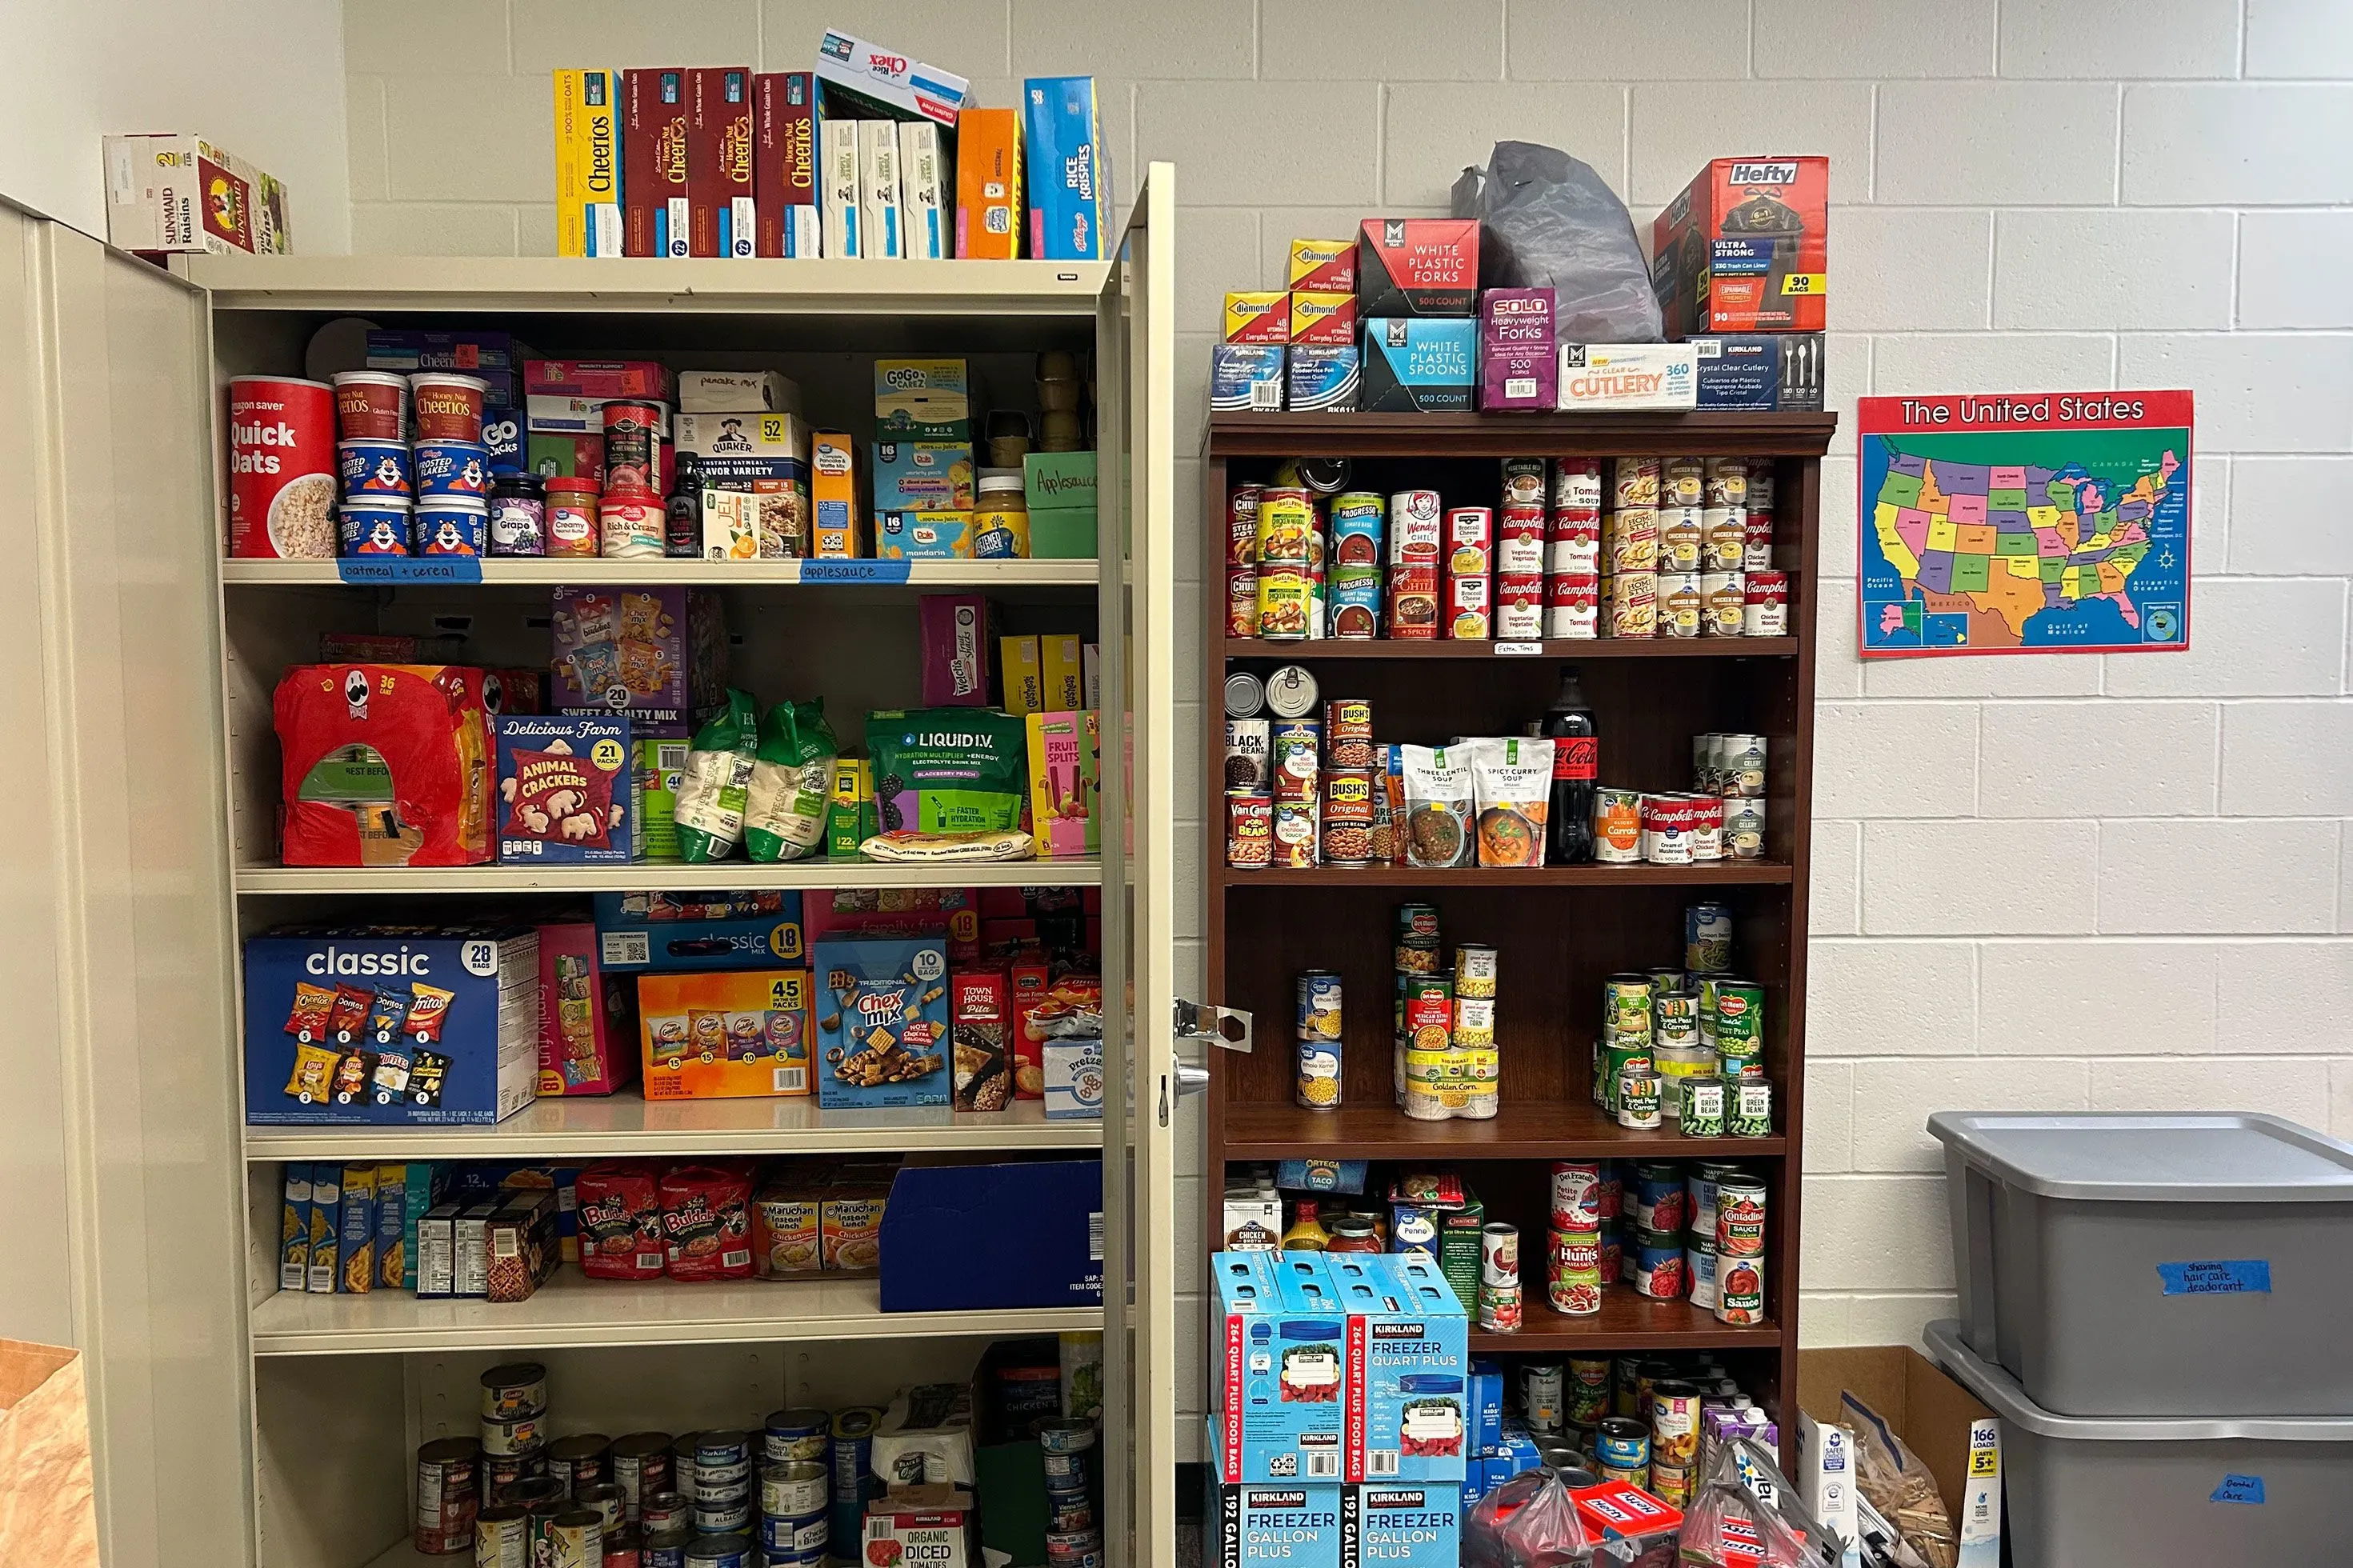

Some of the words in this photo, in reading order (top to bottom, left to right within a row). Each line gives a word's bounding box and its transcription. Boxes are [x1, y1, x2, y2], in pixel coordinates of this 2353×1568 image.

[589, 116, 610, 192] Cheerios
[791, 118, 811, 188] Cheerios
[1066, 157, 1078, 188] RICE
[1078, 144, 1093, 200] KRISPIES
[1733, 164, 1795, 183] Hefty
[182, 198, 191, 243] Raisins
[1415, 246, 1458, 255] WHITE
[1715, 249, 1754, 257] STRONG
[1302, 252, 1336, 262] diamond
[1409, 258, 1464, 270] PLASTIC
[1415, 272, 1458, 282] FORKS
[1792, 278, 1809, 286] 90
[1236, 304, 1271, 313] diamond
[1494, 299, 1547, 314] SOLO
[1491, 317, 1549, 326] Heavyweight
[1499, 326, 1542, 340] Forks
[1416, 342, 1459, 352] WHITE
[1411, 354, 1466, 364] PLASTIC
[1409, 365, 1467, 375] SPOONS
[1666, 365, 1689, 375] 360
[1722, 364, 1739, 372] Clear
[1741, 365, 1769, 374] Cutlery
[701, 376, 737, 387] pancake
[741, 378, 756, 387] mix
[1571, 374, 1663, 396] CUTLERY
[256, 402, 283, 410] saver
[418, 399, 470, 416] Cheerios
[1902, 401, 1950, 424] The
[1960, 398, 2050, 422] United
[2059, 397, 2144, 420] States
[231, 422, 296, 447] Quick
[482, 421, 517, 445] GO
[764, 421, 780, 437] 52
[713, 442, 752, 453] QUAKER
[882, 446, 894, 455] 16
[231, 450, 280, 474] Oats
[419, 457, 452, 467] FROSTED
[421, 466, 449, 477] FLAKES
[732, 466, 772, 475] VARIETY
[1342, 506, 1376, 518] PROGRESSO
[501, 522, 530, 530] Grape
[607, 522, 622, 530] Rich
[632, 523, 658, 534] Creamy
[1407, 522, 1437, 534] Wendy's
[906, 549, 945, 557] mandarin
[346, 564, 394, 577] oatmeal
[413, 566, 455, 577] cereal
[805, 566, 875, 578] applesauce
[1339, 578, 1374, 590] PROGRESSO
[1498, 645, 1518, 653] Extra
[503, 722, 574, 735] Delicious
[577, 723, 621, 737] Farm
[918, 733, 972, 748] LIQUID
[974, 734, 993, 748] I.V.
[1226, 734, 1261, 746] BLACK
[599, 746, 615, 758] 21
[1049, 741, 1078, 752] FRUIT
[1241, 746, 1265, 754] BEANS
[1048, 752, 1078, 763] SPLITS
[522, 762, 578, 776] ANIMAL
[1442, 767, 1468, 775] LENTIL
[522, 775, 587, 796] CRACKERS
[1332, 784, 1367, 796] BUSH'S
[1331, 805, 1368, 814] Original
[1651, 808, 1693, 822] Campbell's
[1608, 826, 1636, 834] Carrots
[775, 930, 796, 946] 18
[471, 945, 491, 962] 28
[306, 946, 430, 975] classic
[919, 954, 937, 966] 10
[773, 981, 798, 997] 45
[963, 987, 991, 995] TOWN
[299, 994, 329, 1007] Cheetos
[338, 998, 363, 1010] Doritos
[413, 996, 443, 1010] Fritos
[858, 990, 903, 1012] Chex
[964, 995, 993, 1003] HOUSE
[866, 1006, 903, 1025] mix
[967, 1005, 989, 1014] Pita
[1306, 1159, 1339, 1169] ORTEGA
[586, 1208, 630, 1224] Buldak
[766, 1206, 814, 1216] Maruchan
[1725, 1211, 1763, 1222] Contadina
[774, 1222, 799, 1230] Lunch
[1561, 1248, 1598, 1261] Hunt's
[2184, 1272, 2205, 1281] hair
[2209, 1272, 2231, 1280] care
[2187, 1281, 2244, 1293] deodorant
[1727, 1298, 1759, 1307] Sauce
[1231, 1324, 1239, 1341] 264
[1375, 1326, 1422, 1334] KIRKLAND
[1372, 1342, 1441, 1354] FREEZER
[1230, 1346, 1239, 1382] QUART
[1372, 1356, 1419, 1366] QUART
[1423, 1356, 1457, 1366] PLUS
[1230, 1387, 1239, 1411] PLUS
[1229, 1414, 1238, 1444] FOOD
[1973, 1429, 1995, 1441] 166
[1228, 1447, 1237, 1474] BAGS
[1975, 1458, 1993, 1469] 5+
[2227, 1480, 2254, 1489] Dental
[2222, 1491, 2243, 1500] Care
[1247, 1513, 1335, 1527] FREEZER
[907, 1531, 948, 1542] ORGANIC
[1247, 1531, 1317, 1542] GALLON
[906, 1545, 950, 1559] DICED
[1247, 1546, 1291, 1558] PLUS
